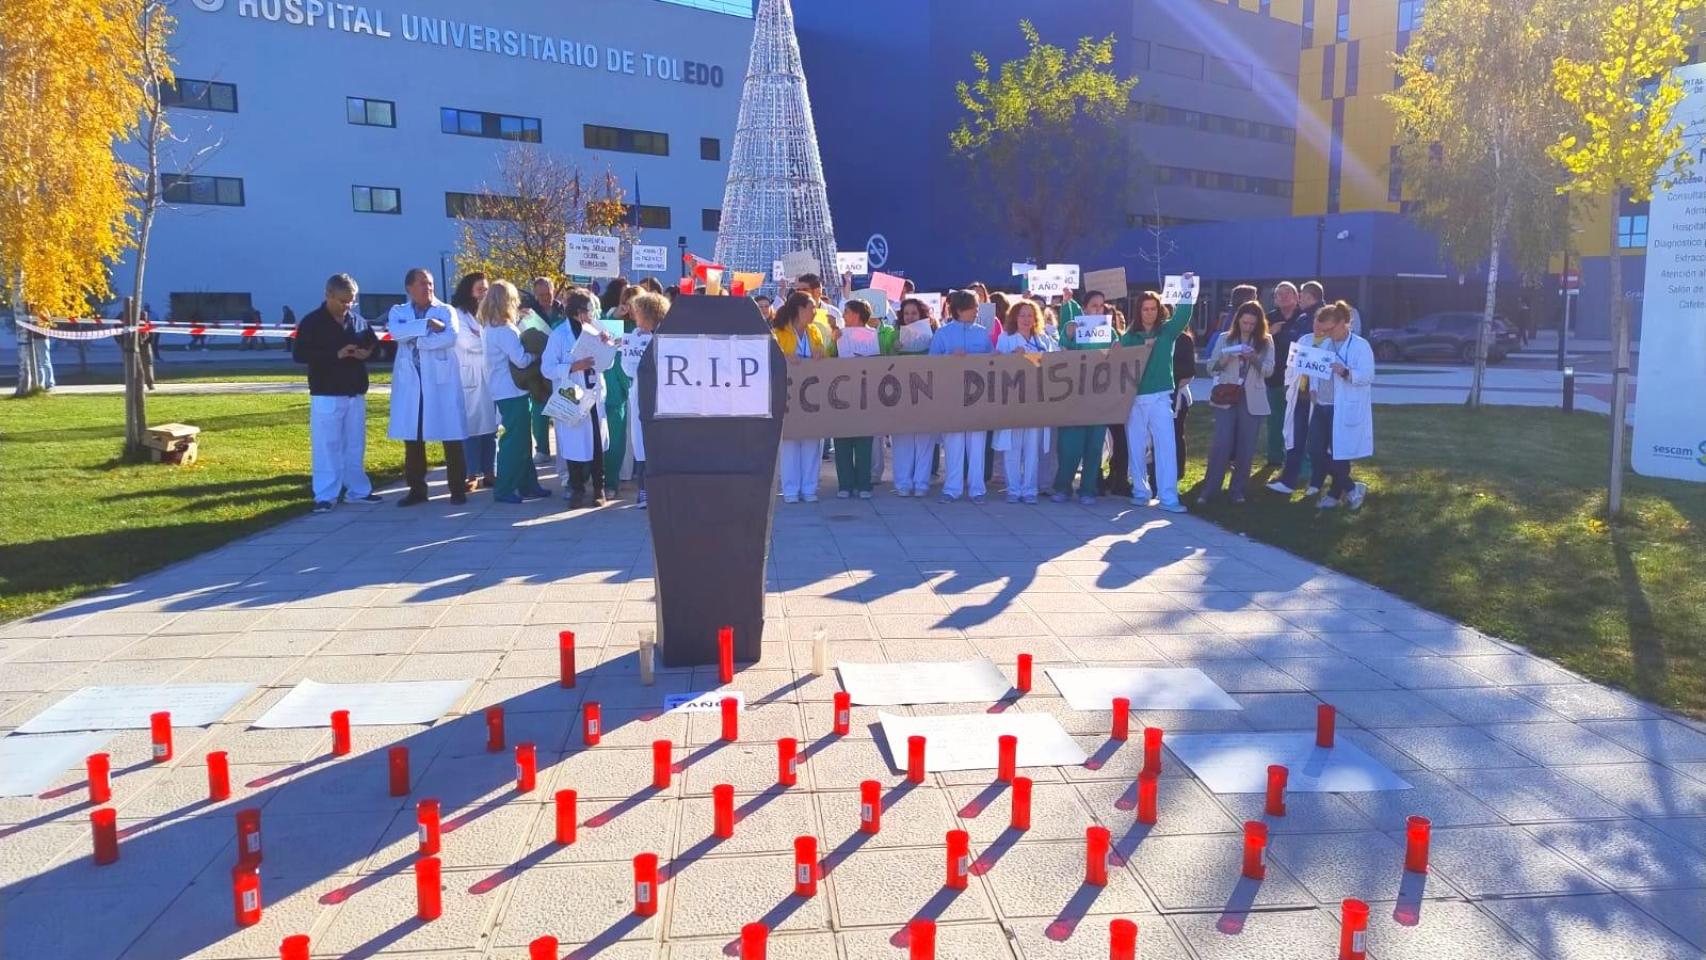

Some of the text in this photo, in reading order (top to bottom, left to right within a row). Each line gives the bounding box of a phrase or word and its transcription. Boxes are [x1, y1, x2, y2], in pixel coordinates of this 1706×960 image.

[239, 0, 724, 88] HOSPITAL UNIVERSITARIO DE TOLEDO
[664, 355, 759, 387] R.I.P
